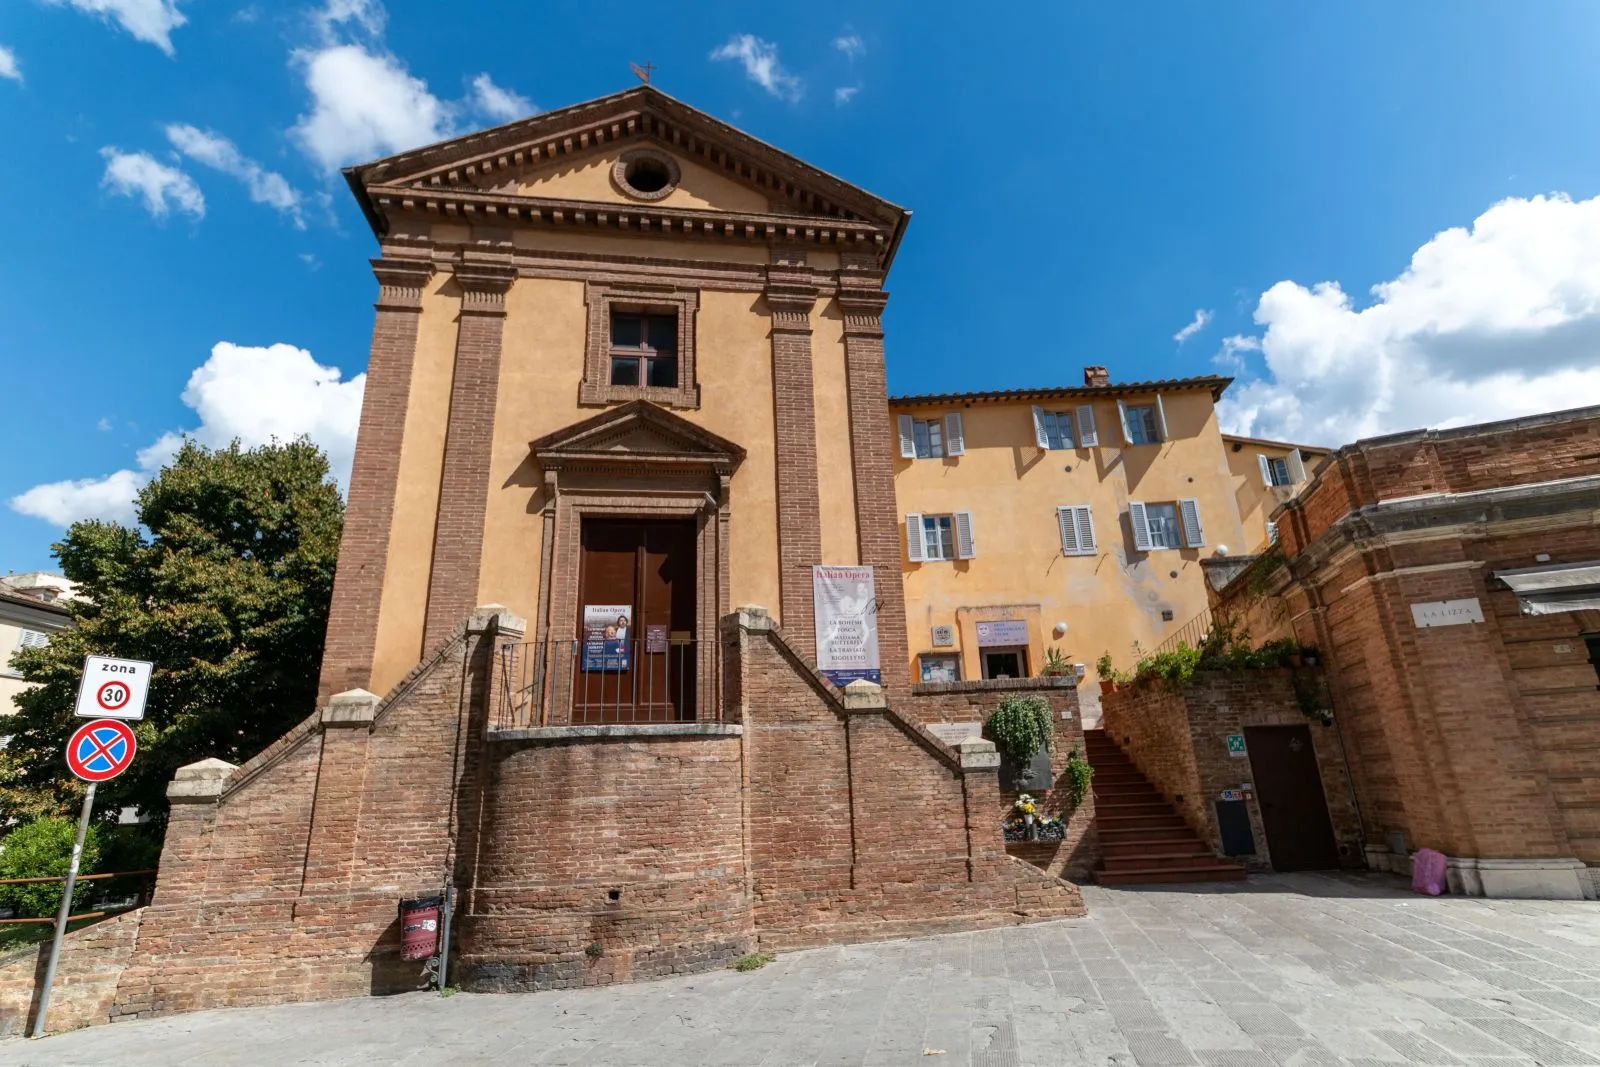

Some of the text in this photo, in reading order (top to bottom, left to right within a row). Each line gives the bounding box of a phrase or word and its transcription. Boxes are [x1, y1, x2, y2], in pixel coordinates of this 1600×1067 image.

[816, 570, 870, 581] Italian Opera
[1423, 607, 1473, 619] LA LIZZA
[101, 663, 136, 674] zona
[104, 688, 123, 703] 30
